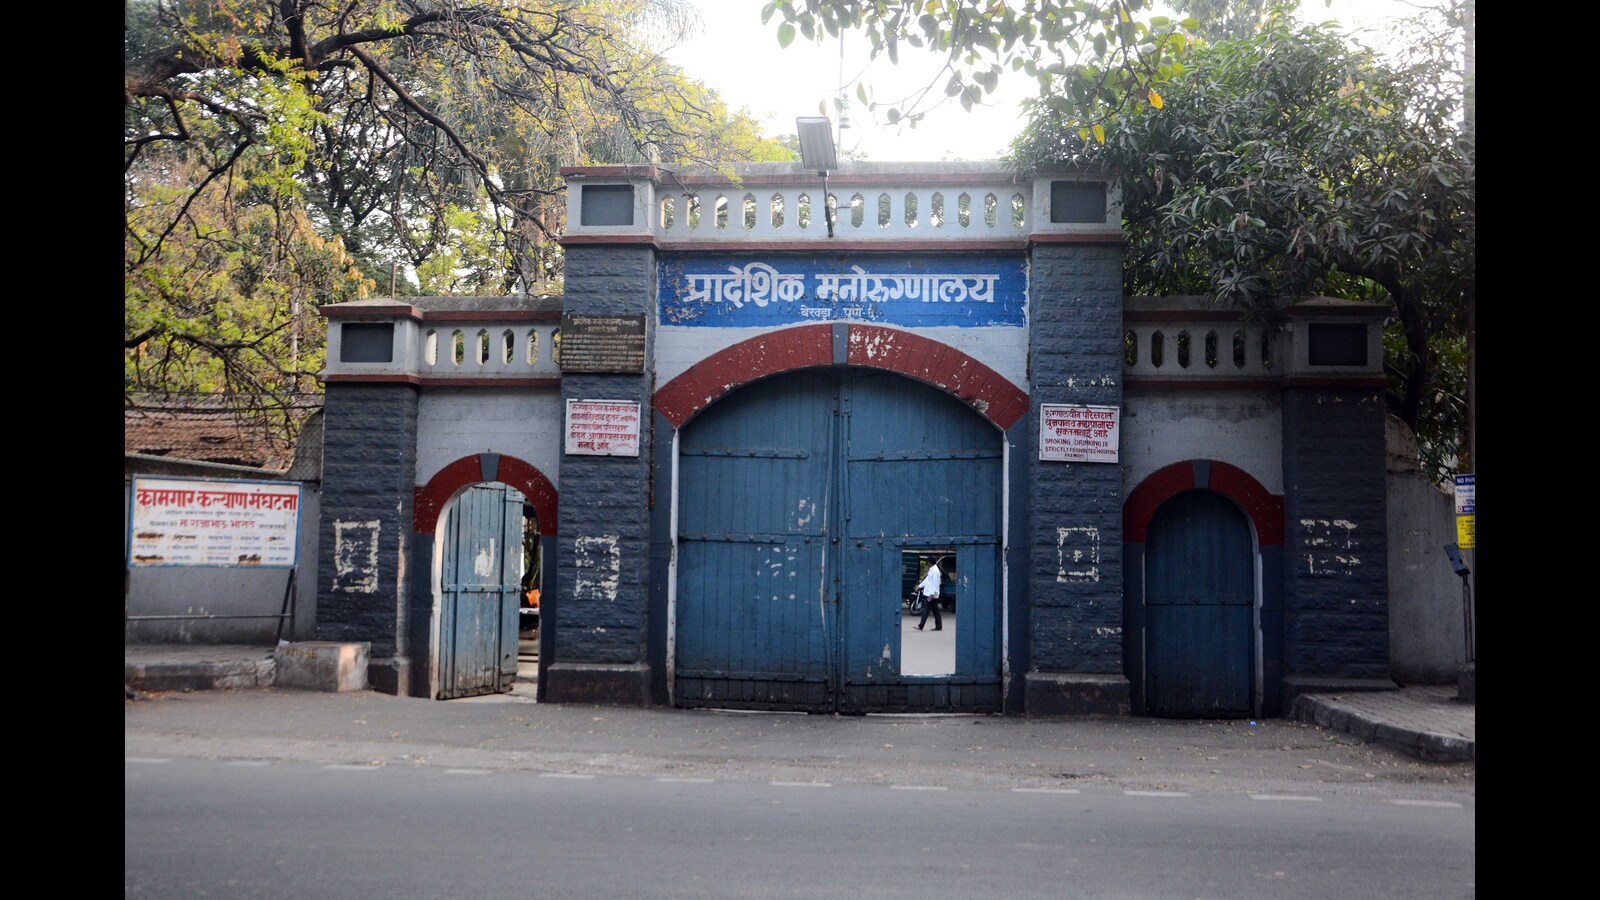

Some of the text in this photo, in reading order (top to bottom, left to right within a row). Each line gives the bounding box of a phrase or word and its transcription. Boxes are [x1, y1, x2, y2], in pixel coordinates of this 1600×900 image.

[682, 262, 1000, 308] प्रादेशिक मनोरुग्णालय
[1082, 409, 1114, 420] परिसरात
[1094, 428, 1109, 438] आहे
[1074, 439, 1101, 447] DRINKING
[136, 488, 196, 508] कामगार
[197, 490, 248, 509] कल्याण
